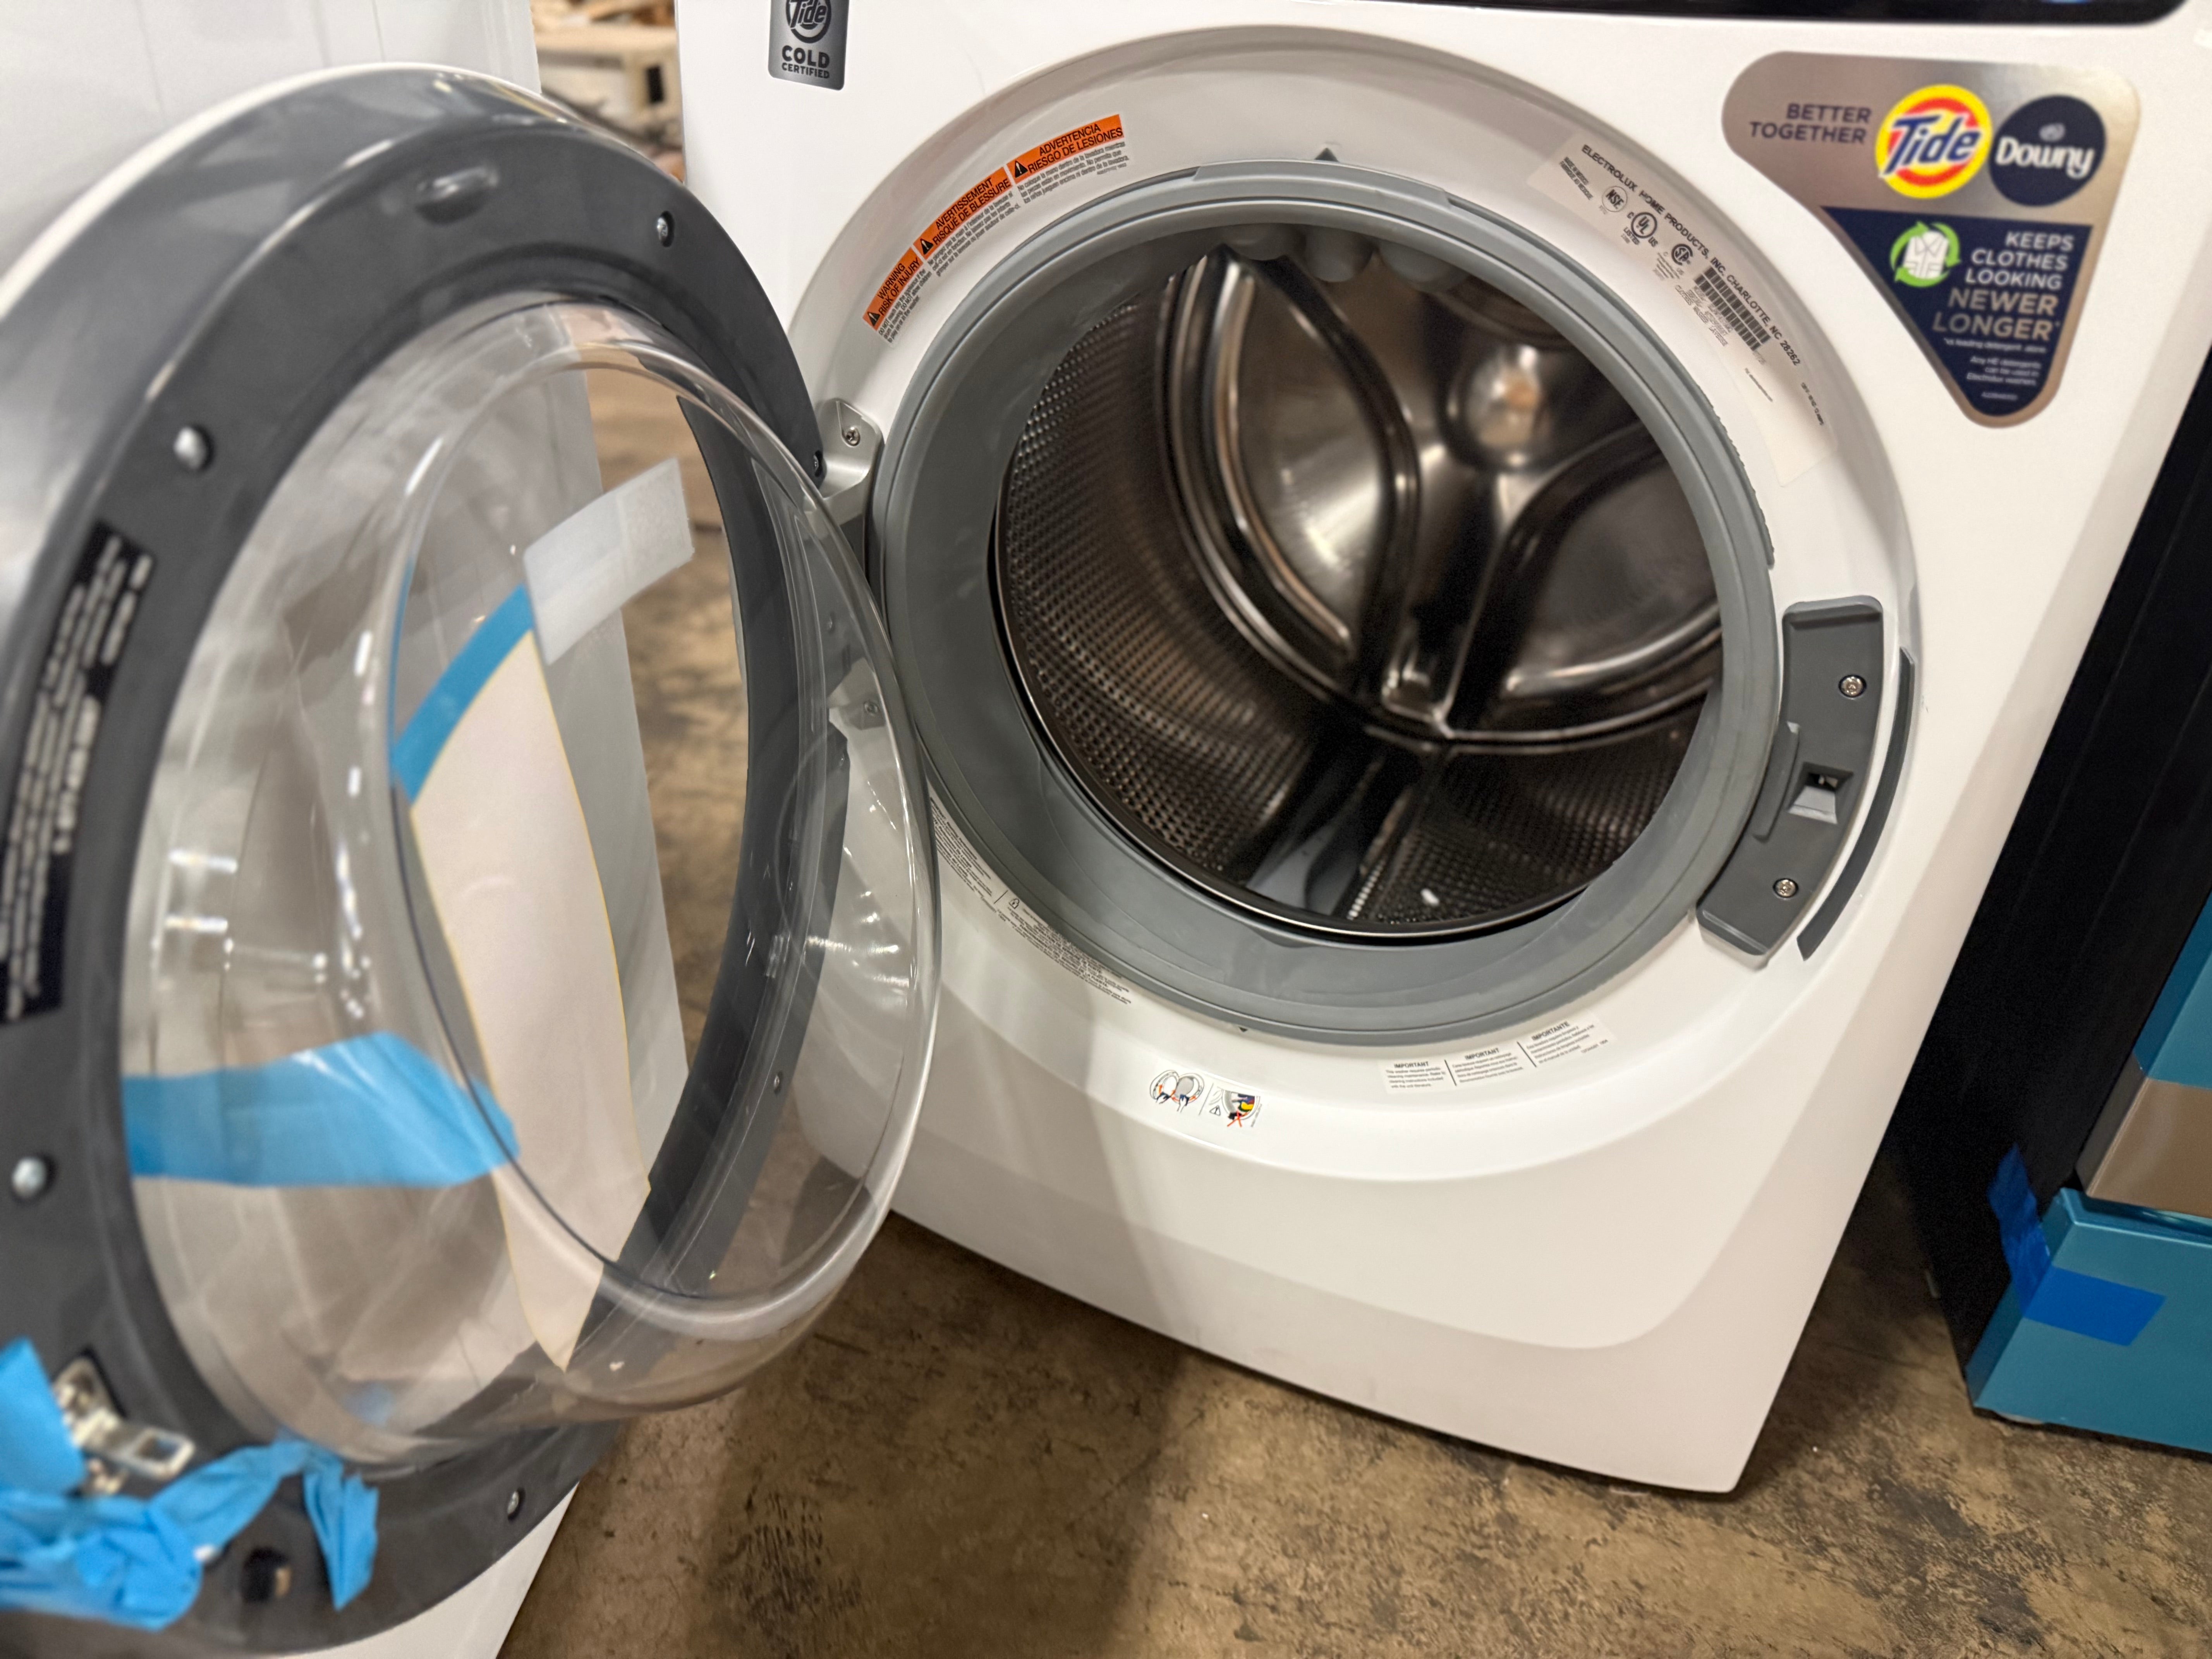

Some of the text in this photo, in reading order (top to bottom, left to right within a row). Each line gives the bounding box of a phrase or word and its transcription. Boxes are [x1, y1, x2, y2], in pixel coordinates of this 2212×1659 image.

[789, 0, 827, 29] Tide
[781, 62, 830, 79] CERTIFIED
[782, 45, 830, 69] COLD
[1786, 103, 1872, 125] BETTER
[1039, 123, 1101, 156] ADVERTENCIA
[1749, 121, 1867, 144] TOGETHER
[1880, 114, 1982, 177] Tide
[1027, 127, 1123, 173] RIESGO DE LESIONES
[1995, 138, 2096, 178] Downy
[936, 177, 993, 230] AVERTISSEMENT
[958, 207, 971, 222] DE
[969, 178, 1011, 213] BLESSURE
[1636, 214, 1650, 234] UL
[1648, 236, 1658, 247] US
[2005, 231, 2075, 252] KEEPS
[1582, 144, 1638, 192] ELECTROLUX
[1639, 190, 1665, 214] HOME
[1664, 213, 1709, 259] PRODUCTS,
[1710, 257, 1726, 276] INC.
[1727, 275, 1771, 326] CHARLOTTE,
[1769, 326, 1782, 340] NC
[1780, 340, 1800, 366] 28262
[1971, 249, 2069, 271] CLOTHES
[877, 263, 905, 299] WARNING
[878, 257, 920, 316] RISK OF INJURY
[1965, 271, 2063, 290] LOOKING
[1948, 288, 2058, 315] NEWER
[1532, 1021, 1570, 1040] IMPORTANTE
[1465, 1048, 1499, 1060] IMPORTANT
